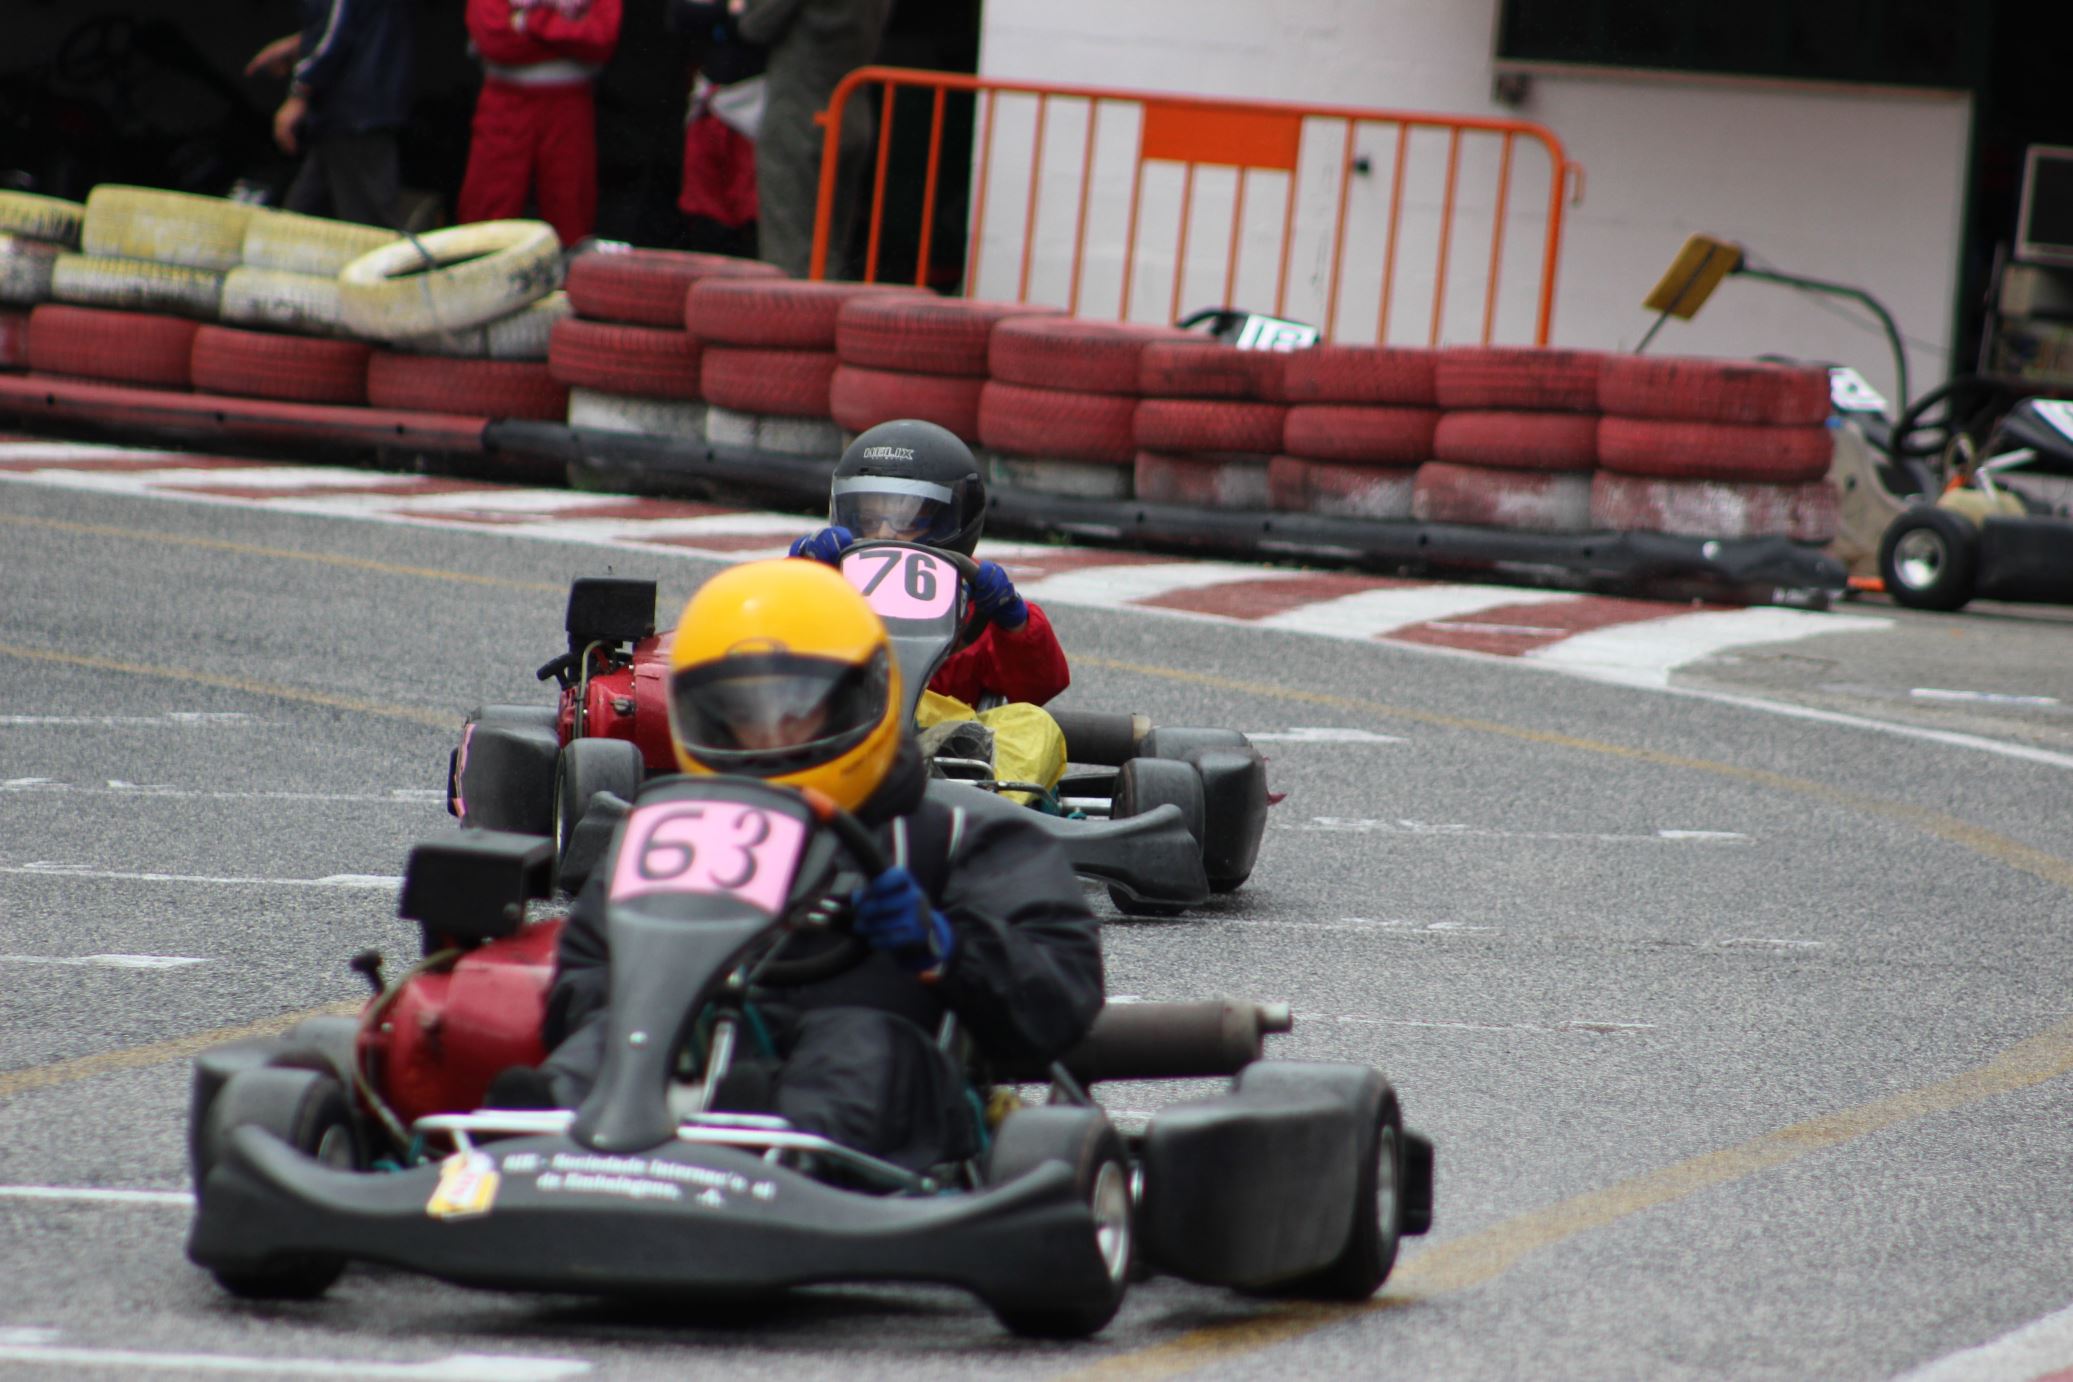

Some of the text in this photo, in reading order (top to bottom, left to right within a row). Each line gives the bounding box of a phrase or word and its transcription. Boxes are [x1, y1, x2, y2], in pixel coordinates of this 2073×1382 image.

[863, 446, 914, 460] HELIX
[859, 550, 937, 602] 76
[634, 807, 771, 888] 63
